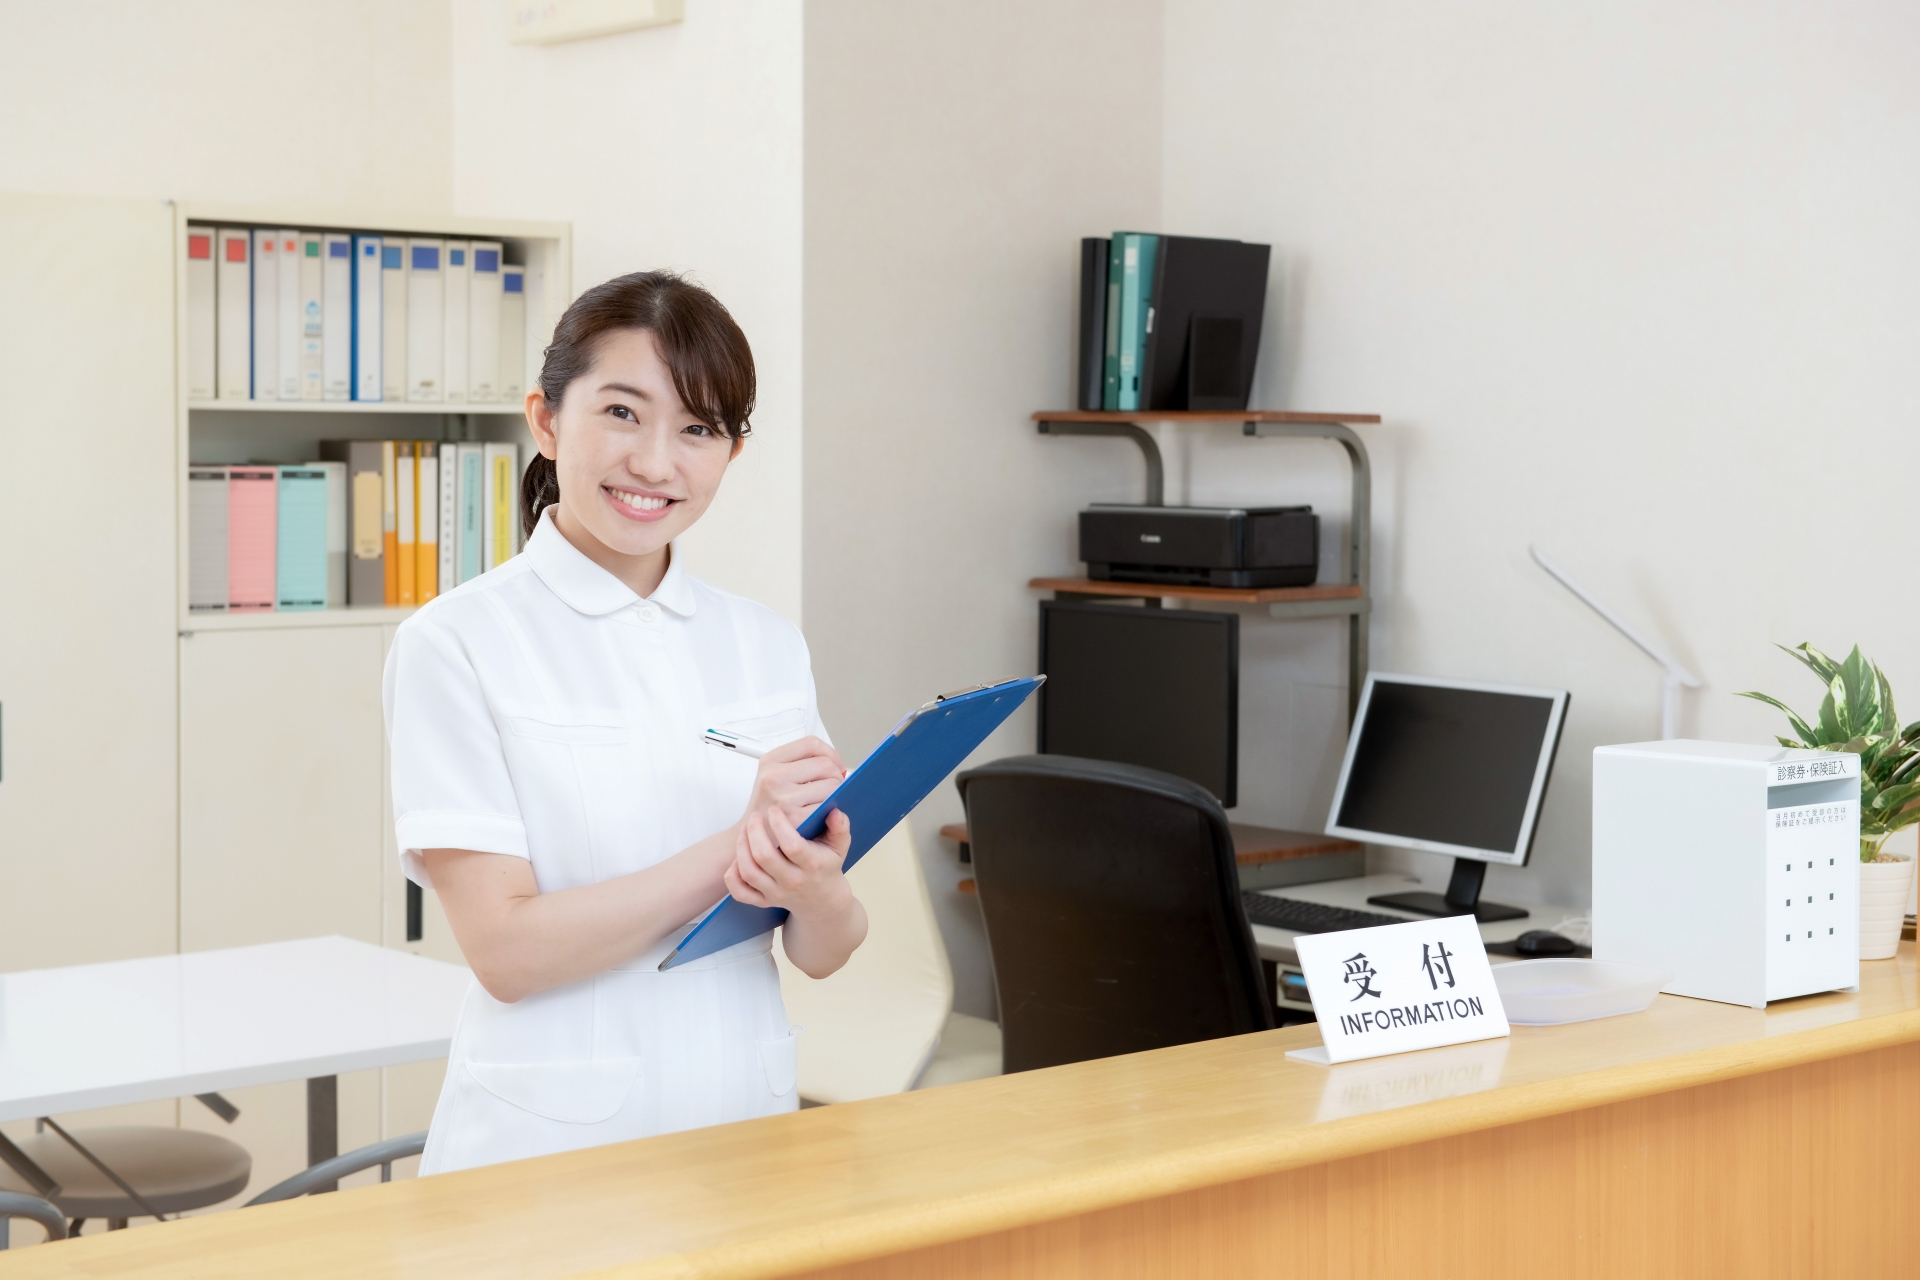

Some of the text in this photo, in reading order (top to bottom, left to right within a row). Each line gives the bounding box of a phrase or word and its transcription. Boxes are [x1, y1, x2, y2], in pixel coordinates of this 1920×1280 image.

[1775, 814, 1847, 829] 保険証をご提示ください
[1340, 996, 1484, 1035] INFORMATION
